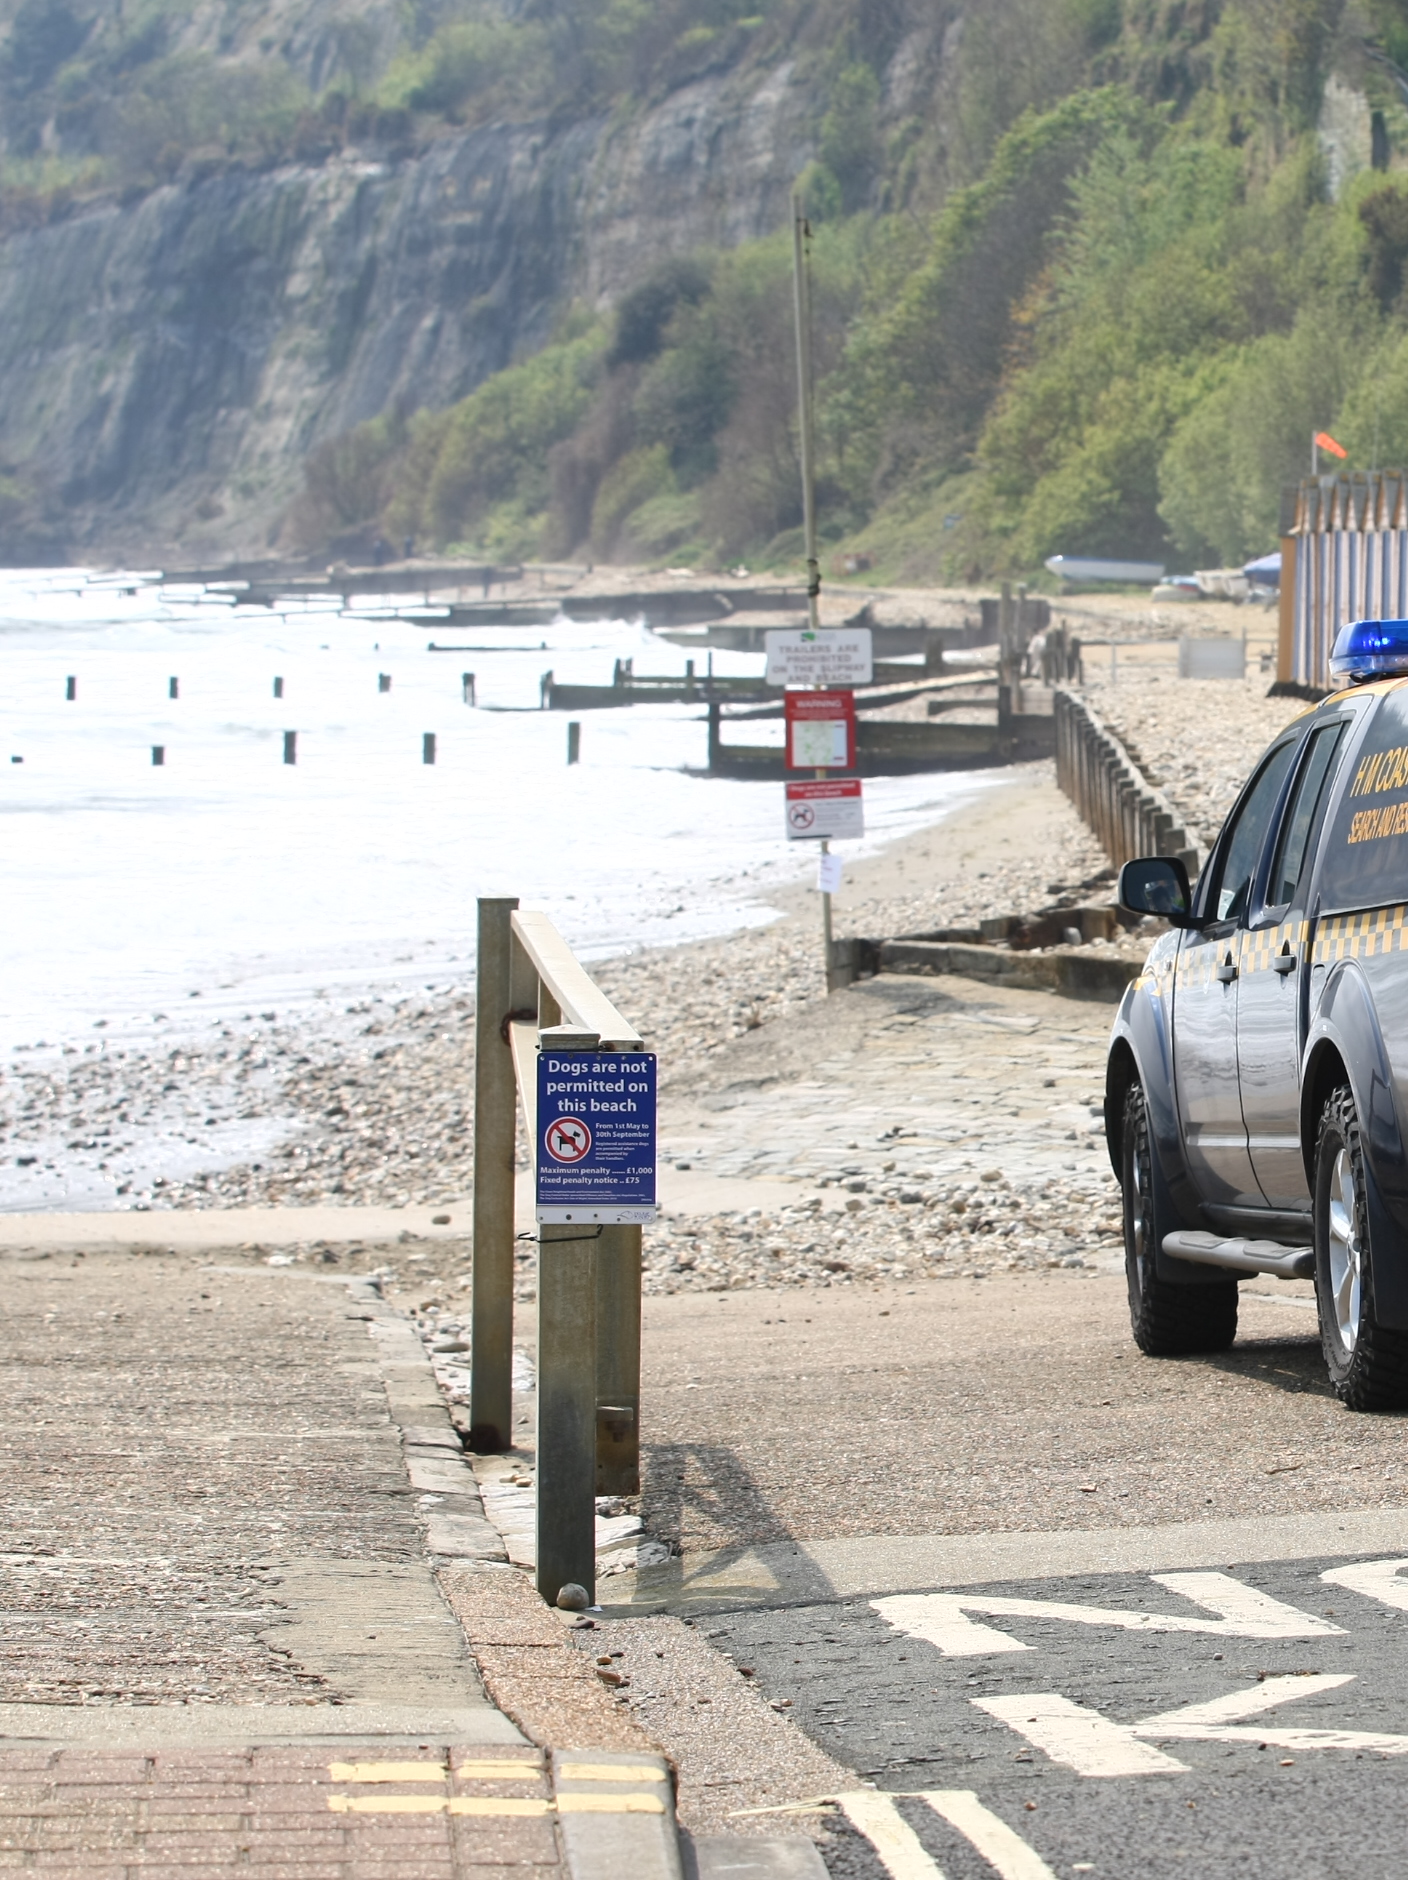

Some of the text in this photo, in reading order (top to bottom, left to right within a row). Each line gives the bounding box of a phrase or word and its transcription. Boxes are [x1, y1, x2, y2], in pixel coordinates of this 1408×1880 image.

[778, 644, 859, 653] TRAILERS ARE
[786, 654, 851, 663] PROHIBITED
[820, 664, 865, 673] SLIPWAY
[816, 674, 852, 682] BEACH
[796, 699, 842, 708] WARNING
[1347, 808, 1382, 844] SEARCH
[548, 1060, 648, 1076] Dogs are not
[547, 1080, 648, 1096] permitted on
[557, 1098, 637, 1112] this beach
[626, 1123, 642, 1131] May
[613, 1131, 650, 1139] September
[581, 1167, 610, 1175] penalty
[563, 1177, 593, 1185] penalty
